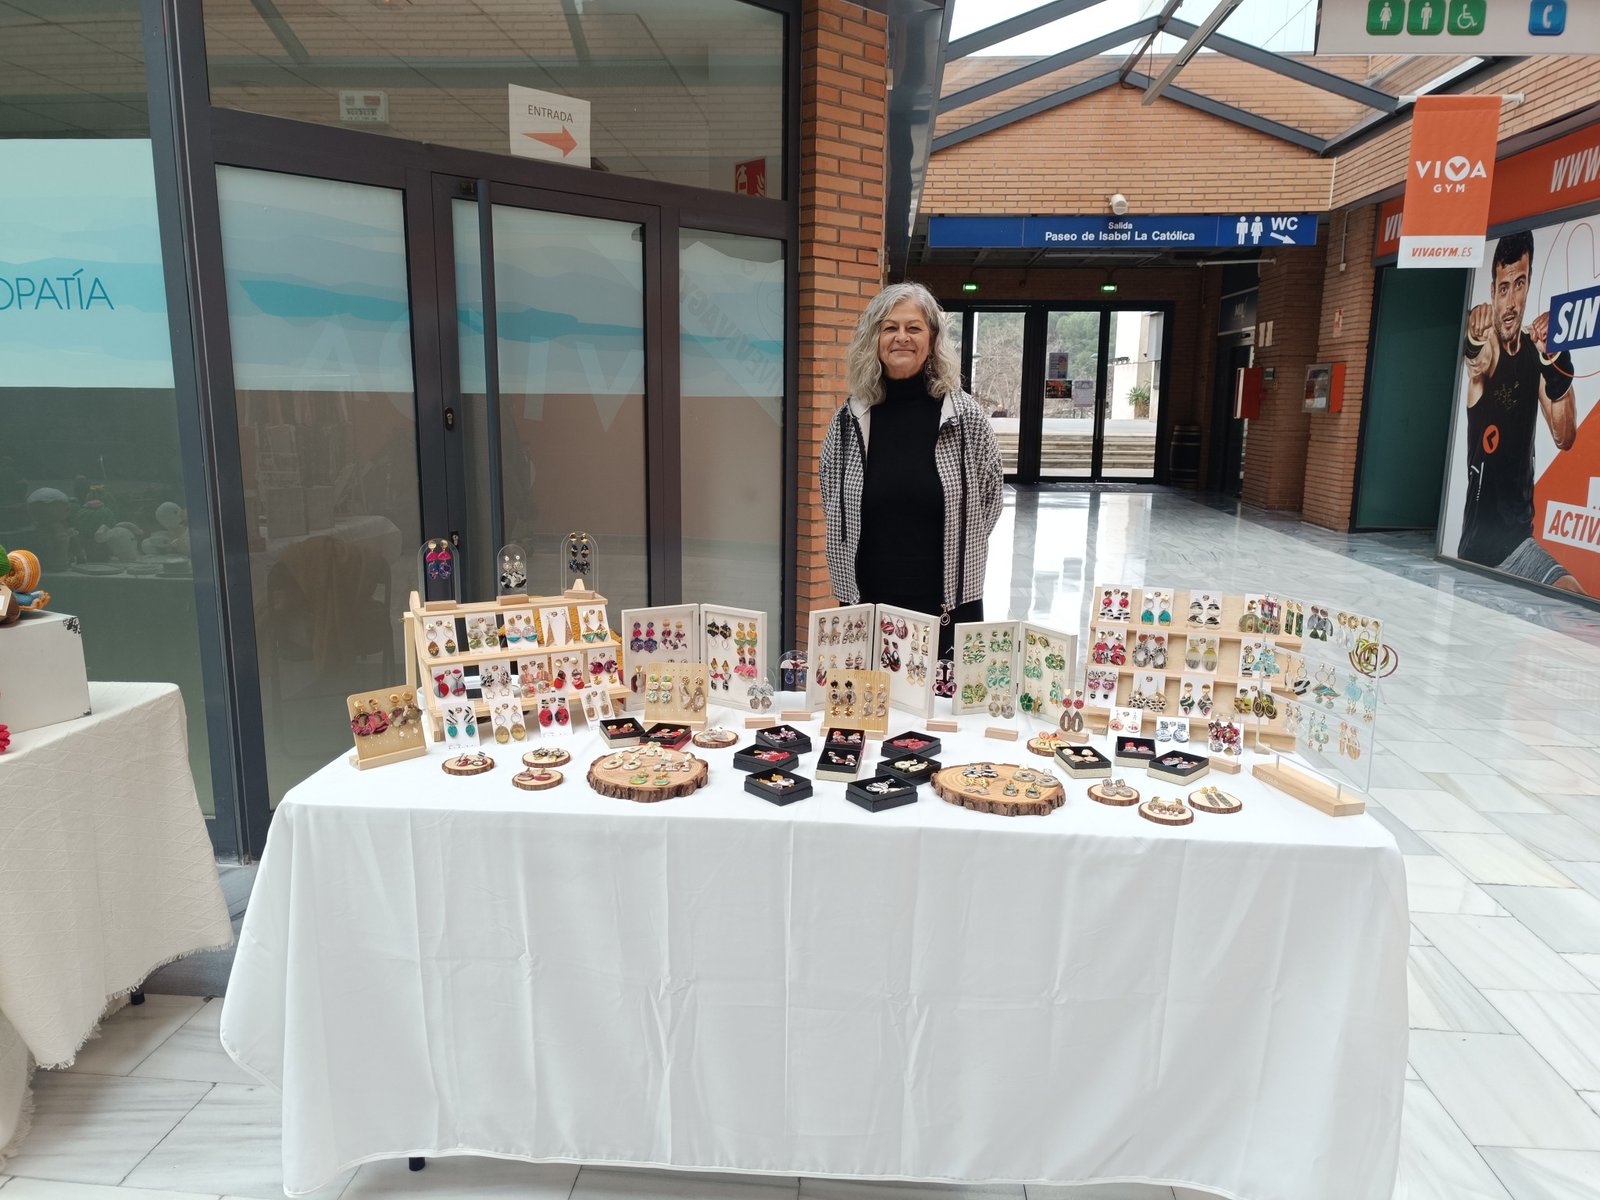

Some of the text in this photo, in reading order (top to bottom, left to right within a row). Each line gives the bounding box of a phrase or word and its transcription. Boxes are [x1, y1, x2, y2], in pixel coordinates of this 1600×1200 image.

[527, 104, 574, 124] ENTRADA
[1415, 155, 1487, 181] VIVA
[1433, 183, 1466, 193] GYM
[1108, 221, 1133, 230] Salida
[1270, 216, 1299, 231] WC
[1045, 230, 1196, 241] Paseo de Isabel La Católica
[1410, 246, 1473, 258] VIVAGYM.ES
[1553, 296, 1600, 344] SIN
[1547, 509, 1600, 545] ACTIV
